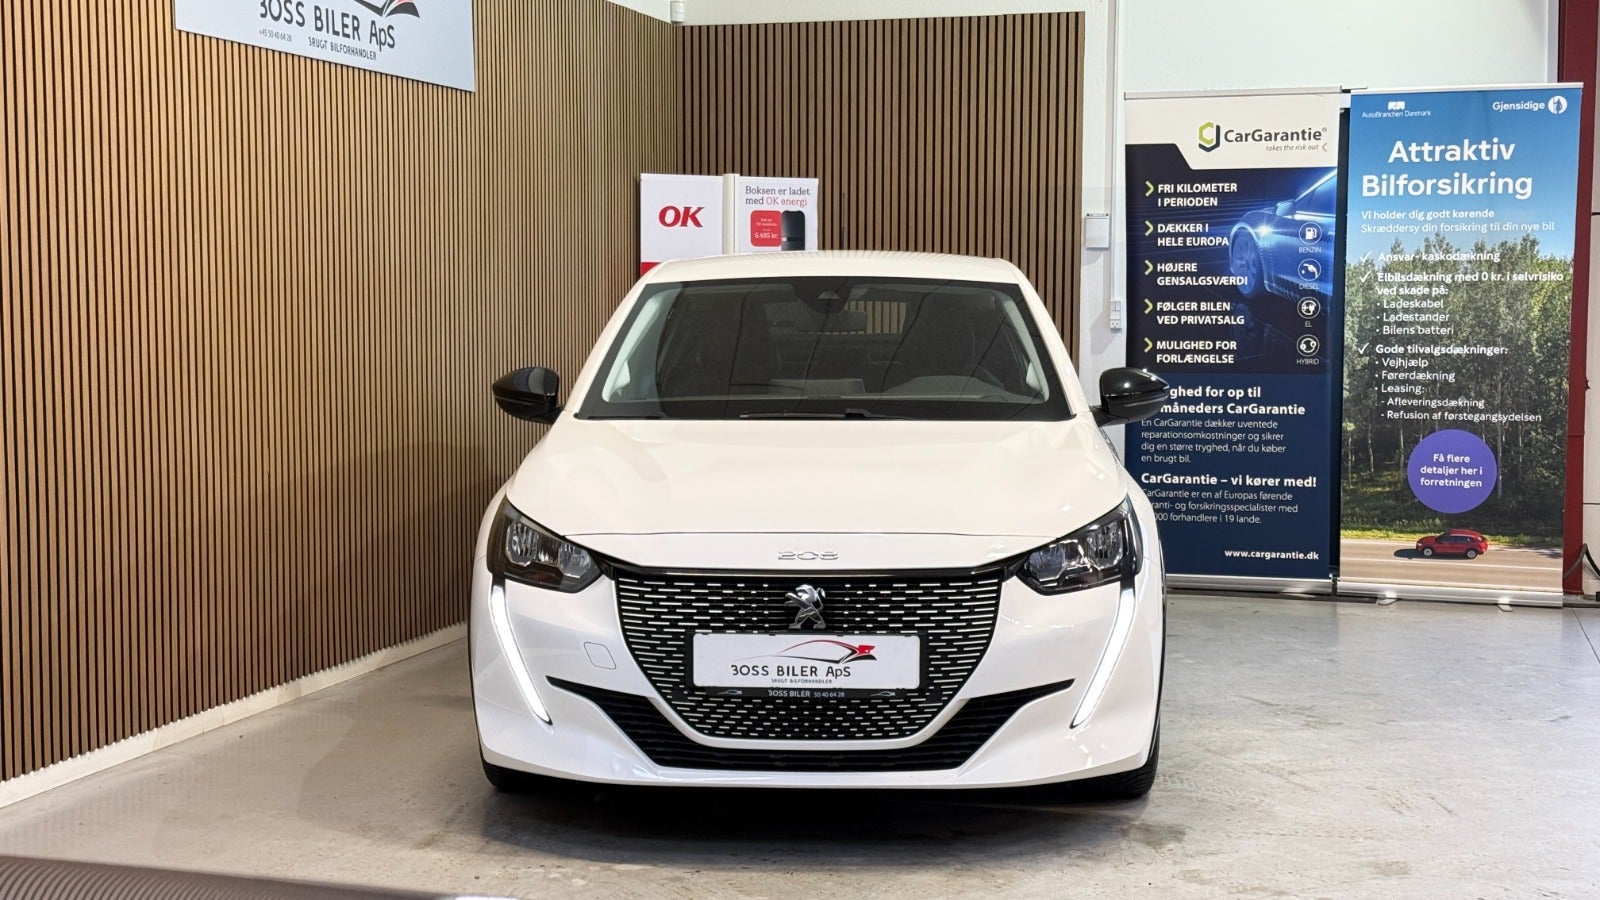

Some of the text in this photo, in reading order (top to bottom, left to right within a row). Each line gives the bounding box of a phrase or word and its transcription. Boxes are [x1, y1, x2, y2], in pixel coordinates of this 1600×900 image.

[314, 5, 361, 41] BILER
[369, 20, 395, 52] ApS
[330, 42, 376, 60] BILFORHANDLER
[1492, 101, 1545, 113] Gjensidige
[1224, 128, 1321, 143] CarGarantie
[1388, 137, 1516, 163] Attraktiv
[746, 186, 776, 194] Boksen
[789, 187, 810, 195] ladet
[1158, 183, 1237, 193] FRI KILOMETER
[1362, 172, 1532, 200] Bilforsikring
[766, 197, 779, 205] OK
[781, 198, 807, 208] energi
[1164, 197, 1218, 207] PERIODEN
[659, 206, 705, 227] OK
[1361, 209, 1495, 221] Vi holder dig godt kørende
[1158, 223, 1203, 233] DÆKKER
[1361, 221, 1555, 235] Skræddersy din forsikring til din nye bil
[1158, 237, 1229, 246] HELE EUROPA
[1378, 252, 1500, 262] Ansvar- kaskodækning
[1158, 263, 1197, 273] HØJERE
[1157, 277, 1248, 286] GENSALGSVÆRDI
[1378, 273, 1452, 283] Elbilsdækning
[1455, 273, 1479, 281] med
[1481, 273, 1488, 281] 0
[1491, 273, 1504, 281] kr.
[1512, 273, 1563, 281] selvrisiko
[1377, 286, 1448, 296] ved skade på:
[1157, 302, 1230, 311] FØLGER BILEN
[1383, 299, 1444, 308] Ladeskabel
[1157, 315, 1244, 325] VED PRIVATSALG
[1383, 313, 1449, 322] Ladestander
[1383, 326, 1454, 335] Bilens batteri
[1157, 341, 1237, 349] MULIGHED FOR
[1376, 345, 1508, 357] Gode tilvalgsdækninger:
[1157, 354, 1234, 364] FORLÆNGELSE
[1382, 358, 1429, 368] Vejhjælp
[1381, 371, 1455, 382] Førerdækning
[1170, 386, 1261, 400] ghed for op til
[1381, 384, 1425, 394] Leasing:
[1161, 402, 1305, 415] måneders CarGarantie
[1387, 398, 1484, 409] Afleveringsdækning
[1387, 411, 1541, 423] Refusion af førstegangsydelsen
[1154, 419, 1202, 427] CarGarantie
[1205, 419, 1235, 428] dækker
[1141, 432, 1245, 441] reparationsomkostninger
[1262, 433, 1284, 441] sikrer
[1141, 443, 1154, 452] dig
[1195, 444, 1230, 453] tryghed,
[1232, 444, 1246, 452] når
[1248, 444, 1259, 452] du
[1262, 445, 1286, 453] køber
[1154, 454, 1176, 464] brugt
[1179, 455, 1191, 463] bil.
[1433, 453, 1470, 463] Få flere
[1420, 466, 1458, 476] detaljer
[1461, 466, 1478, 475] her
[1141, 473, 1217, 485] CarGarantie
[1231, 475, 1242, 485] vi
[1246, 475, 1281, 486] kører
[1284, 476, 1316, 487] med!
[1420, 478, 1482, 488] forretningen
[1214, 490, 1223, 499] af
[1224, 491, 1257, 501] Europas
[1260, 491, 1292, 501] førende
[1151, 502, 1298, 513] ranti- og forsikringsspecialister med
[1170, 513, 1217, 522] forhandlere
[1225, 515, 1234, 523] 19
[1237, 515, 1261, 524] lande.
[778, 551, 839, 560] 208
[1224, 550, 1319, 560] www.cargarantie.dk
[777, 666, 818, 676] BILER
[826, 666, 851, 679] ApS
